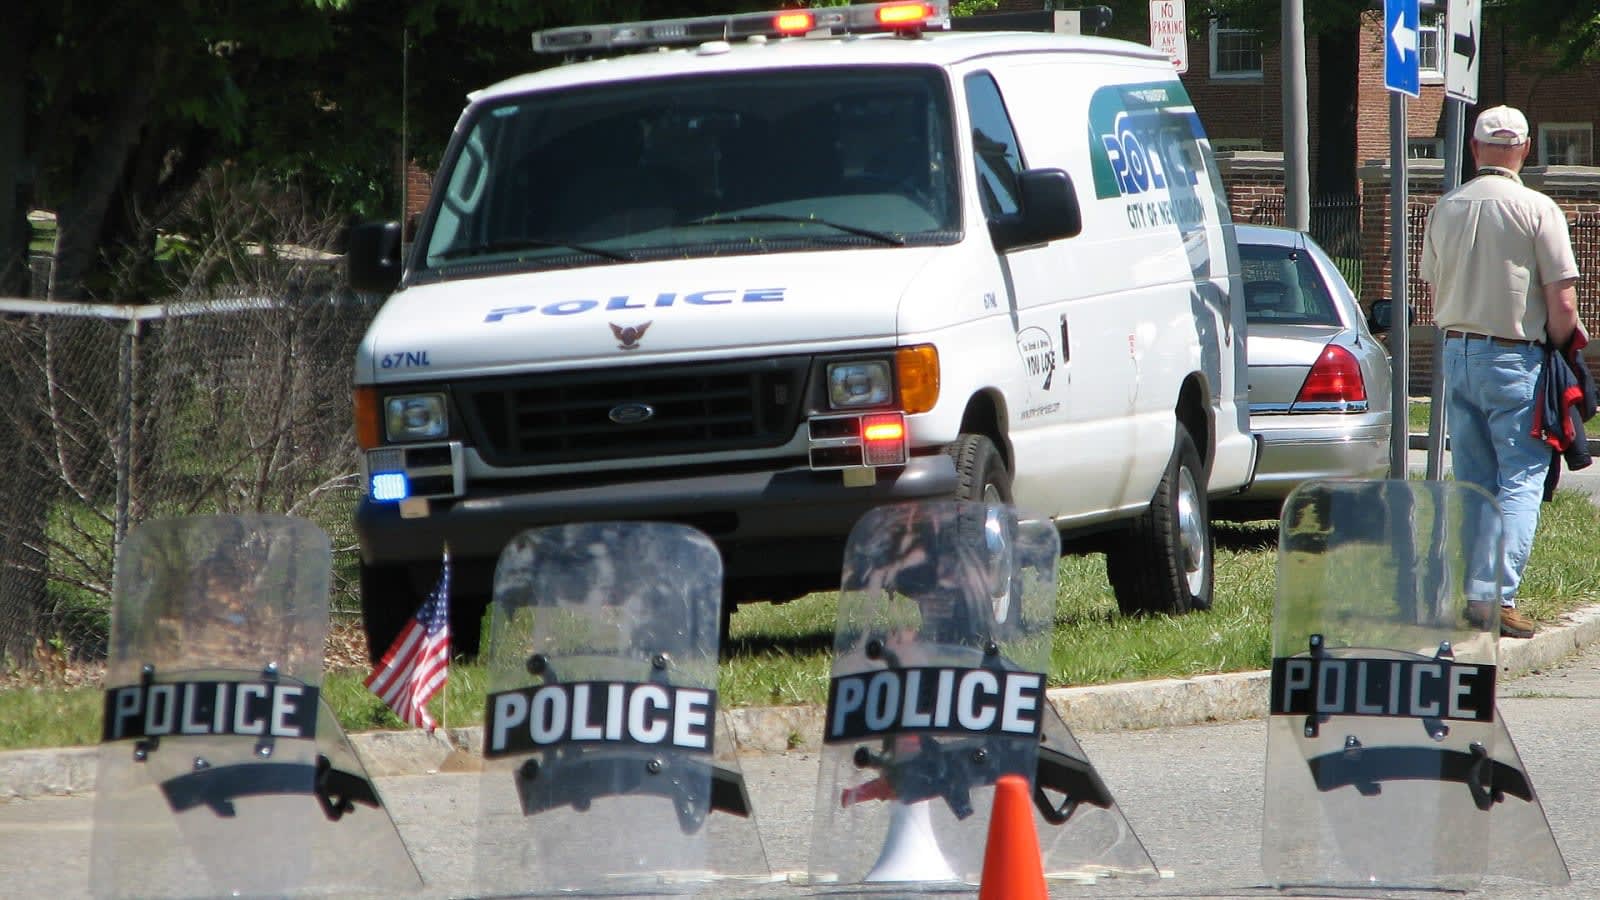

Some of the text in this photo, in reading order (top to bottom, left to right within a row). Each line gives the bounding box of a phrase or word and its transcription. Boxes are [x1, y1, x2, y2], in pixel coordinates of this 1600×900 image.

[1161, 3, 1174, 18] NO
[1152, 20, 1184, 33] PARKING
[1162, 36, 1176, 46] ANY
[1127, 202, 1147, 229] CITY
[1147, 201, 1159, 227] OF
[484, 288, 787, 323] POLICE
[381, 351, 430, 369] 67NL
[1027, 354, 1040, 376] YOU
[832, 669, 1040, 737] POLICE
[1283, 659, 1478, 719] POLICE
[113, 683, 304, 739] POLICE
[492, 683, 709, 751] POLICE
